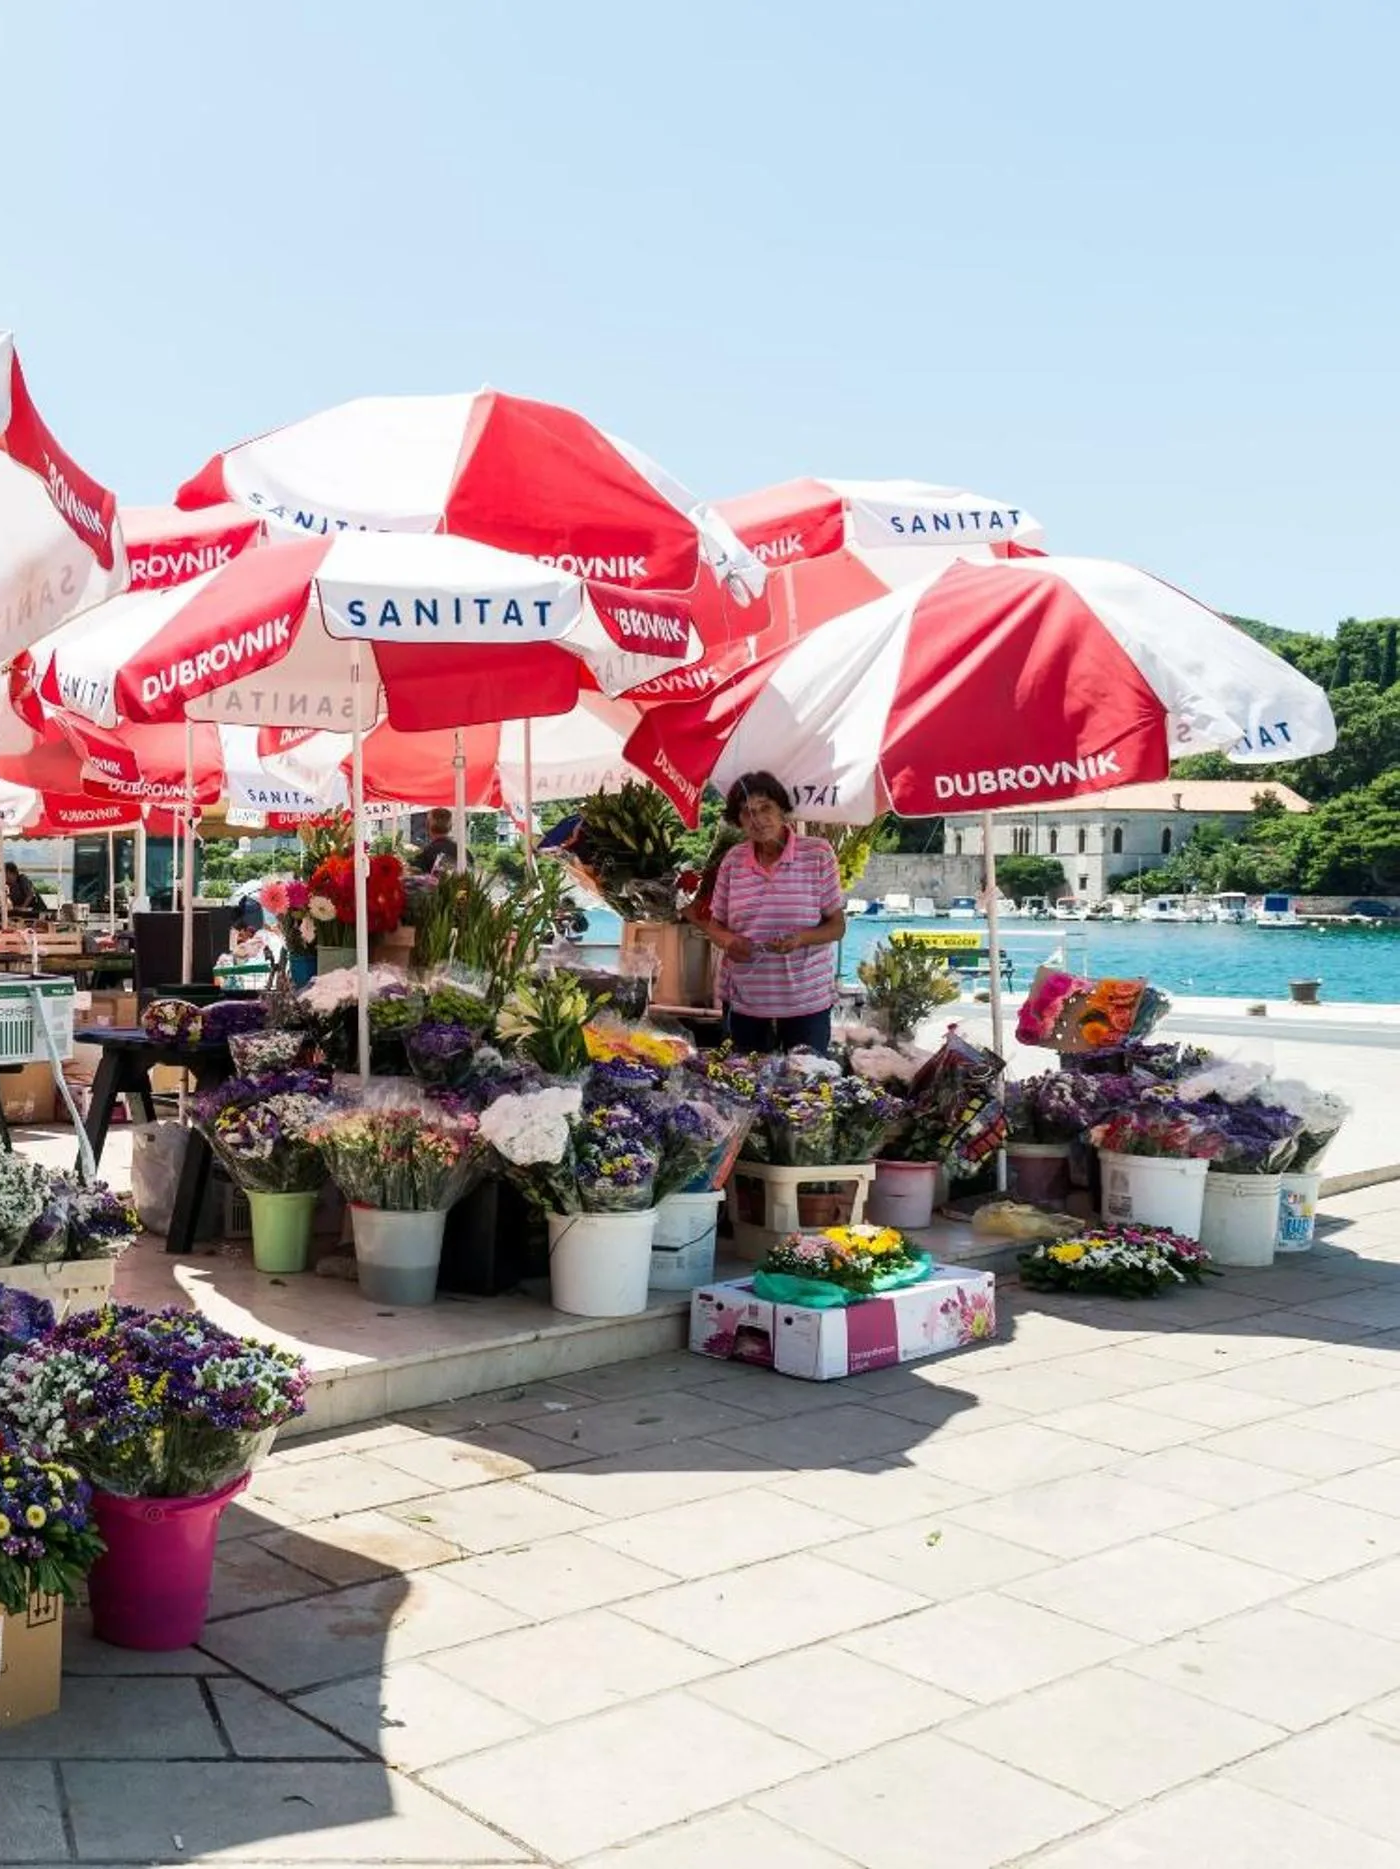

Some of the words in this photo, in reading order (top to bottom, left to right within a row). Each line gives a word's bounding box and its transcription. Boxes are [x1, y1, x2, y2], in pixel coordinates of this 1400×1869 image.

[890, 510, 1021, 534] SANITAT
[348, 597, 552, 626] SANITAT
[141, 614, 291, 703] DUBROVNIK
[934, 752, 1122, 799] DUBROVNIK
